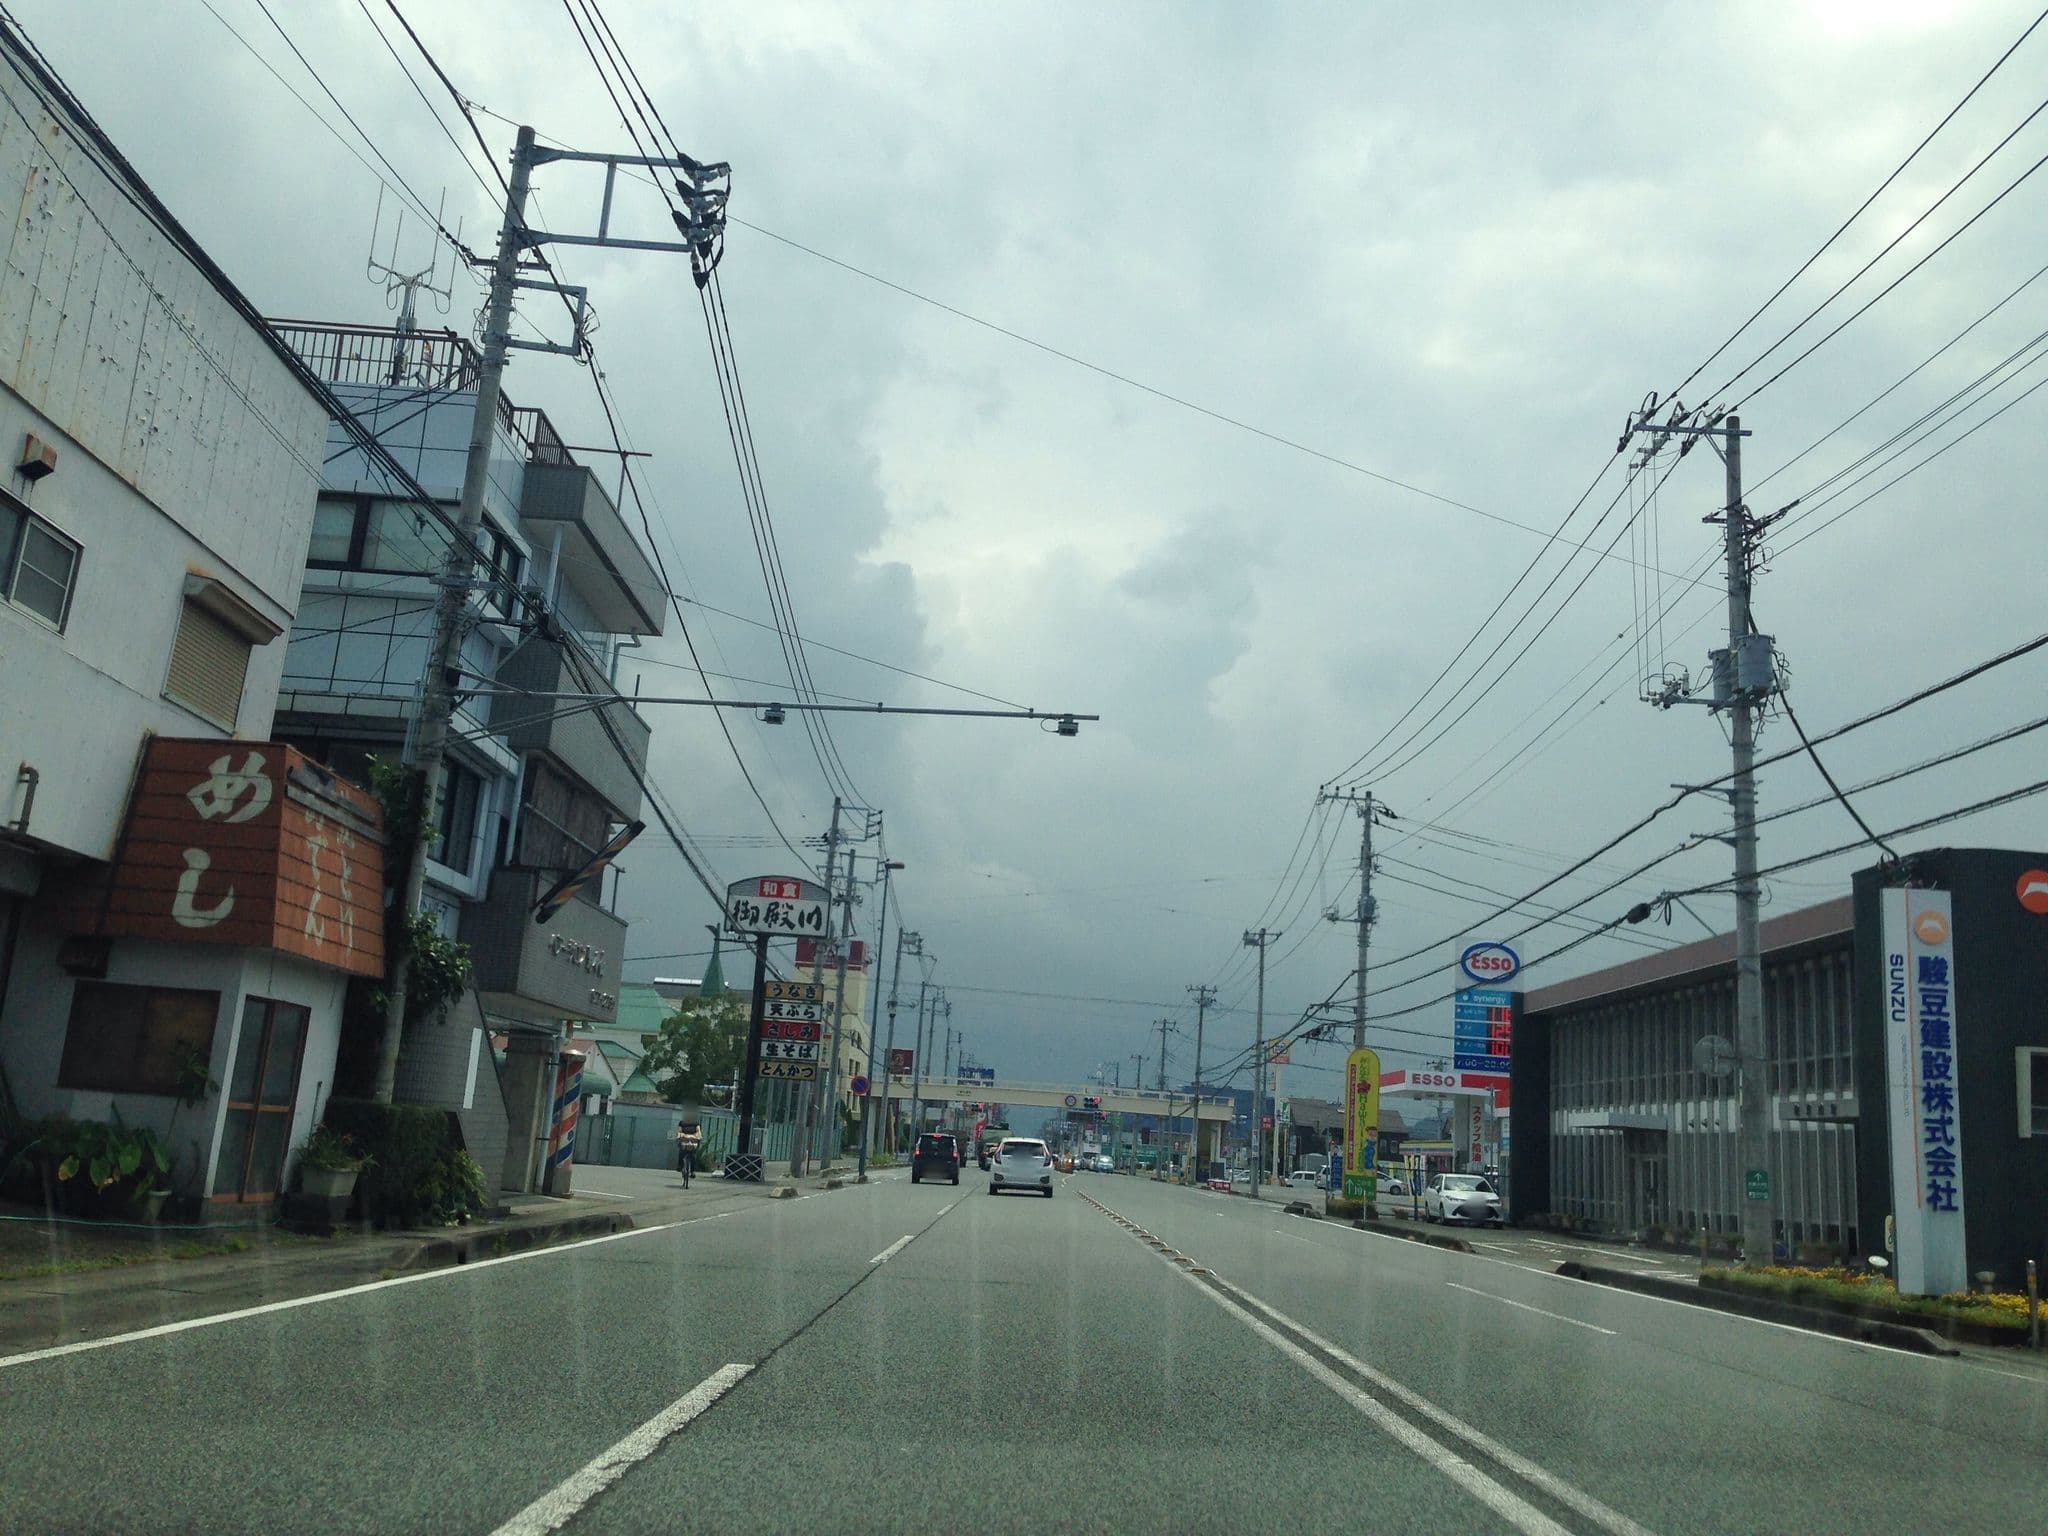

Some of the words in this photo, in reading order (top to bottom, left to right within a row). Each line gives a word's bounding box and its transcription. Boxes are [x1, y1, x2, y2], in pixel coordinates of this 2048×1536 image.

[172, 751, 273, 928] めし
[762, 881, 797, 898] 和食
[734, 900, 822, 931] 御殿川
[772, 983, 817, 999] うなぎ
[1889, 954, 1906, 1023] SUNZU
[767, 1023, 813, 1038] さしみ
[765, 1043, 815, 1058] 生そば
[761, 1062, 814, 1078] とんかつ
[1411, 1073, 1456, 1087] ESSO
[1917, 955, 1959, 1213] 駿豆建設株式会社
